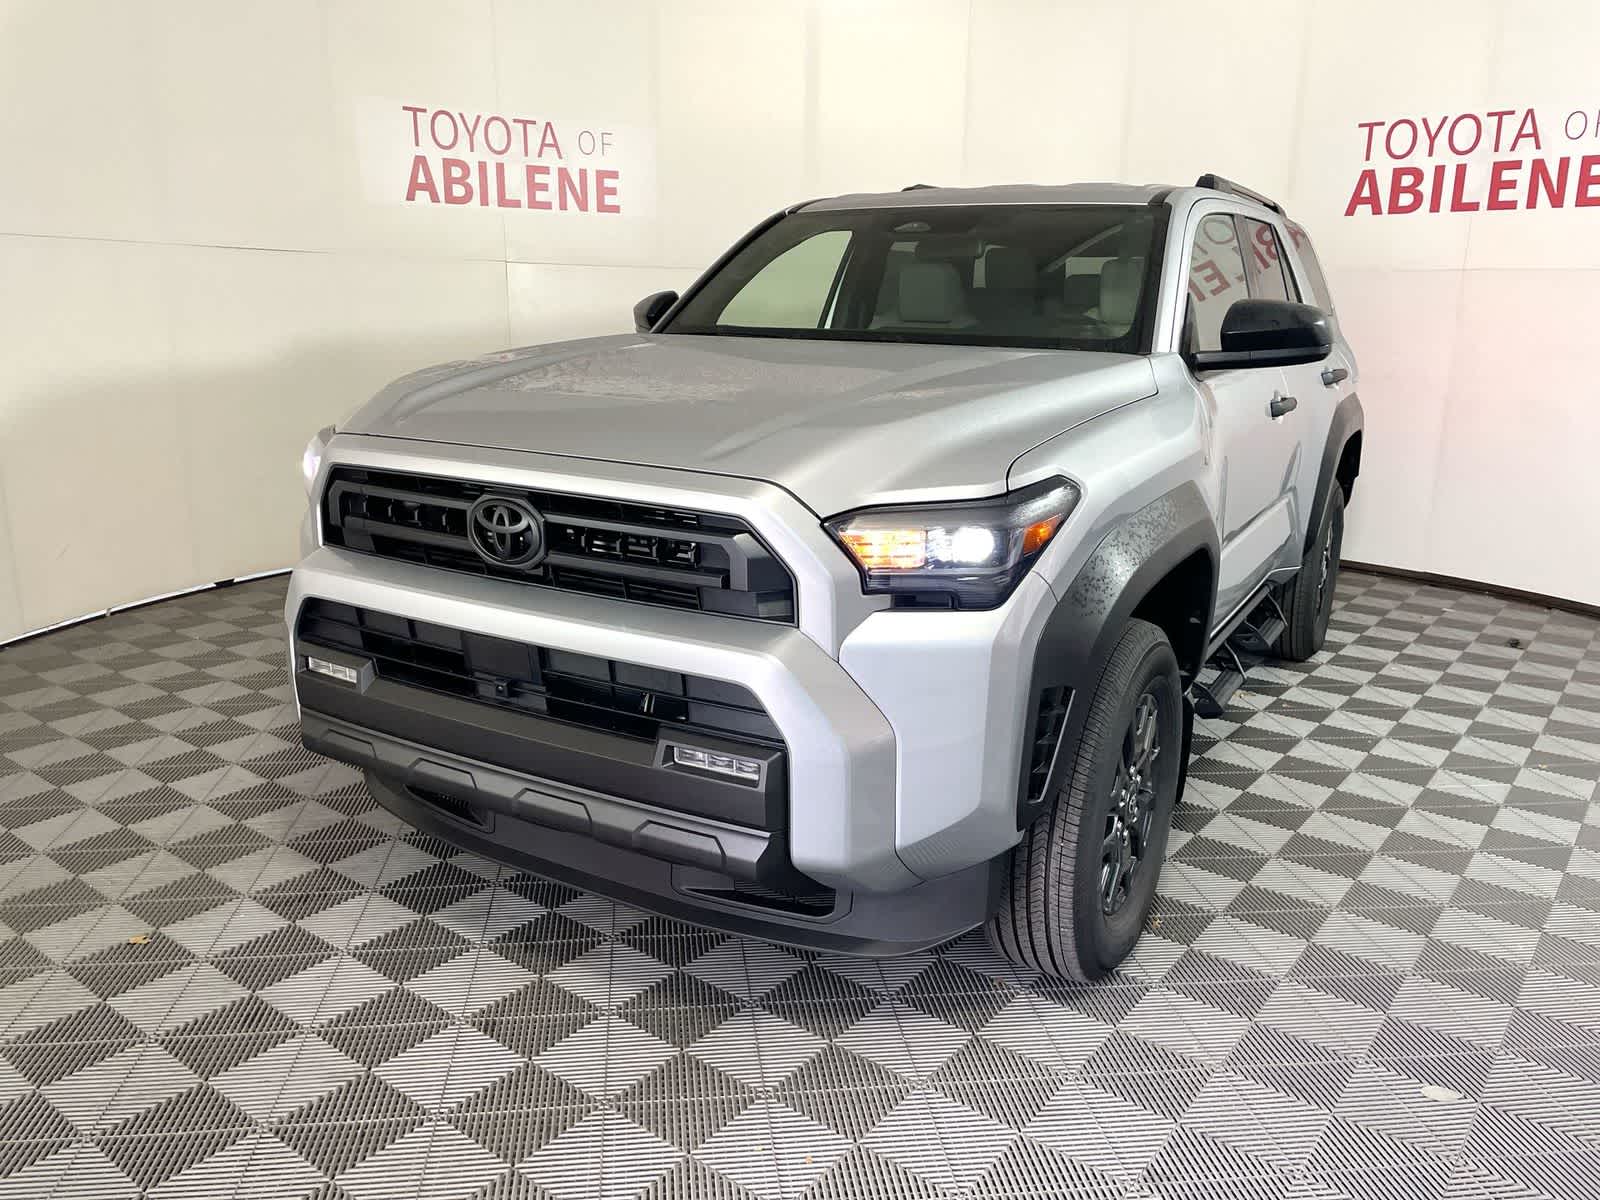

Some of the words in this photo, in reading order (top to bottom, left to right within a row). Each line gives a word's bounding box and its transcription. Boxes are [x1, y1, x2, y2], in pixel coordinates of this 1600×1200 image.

[402, 105, 563, 159] TOYOTA
[578, 130, 613, 156] OF
[1358, 108, 1541, 161] TOYOTA
[405, 154, 621, 214] ABILENE
[1344, 154, 1600, 216] ABILENE
